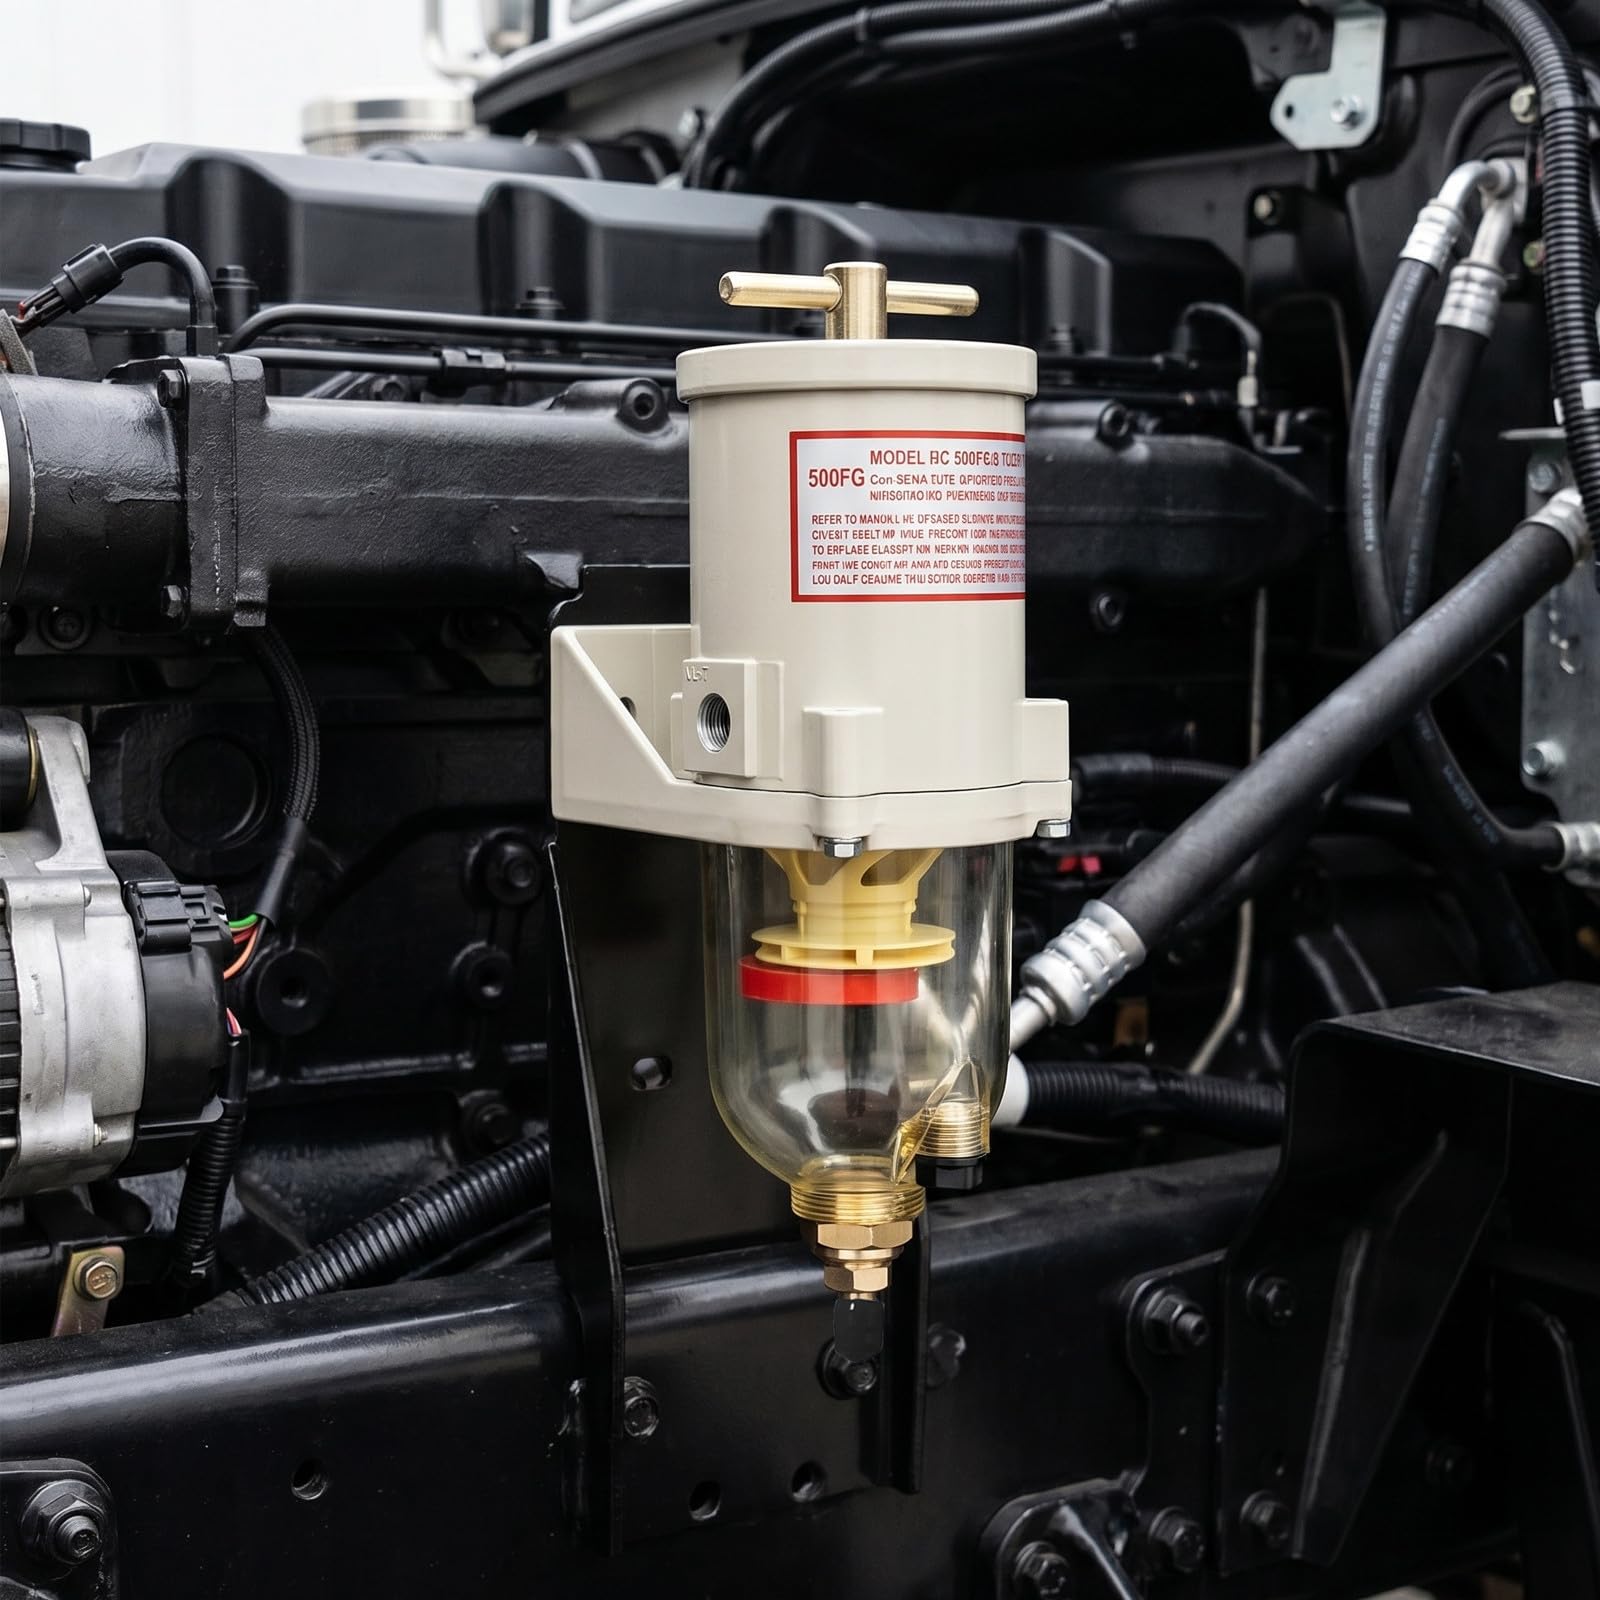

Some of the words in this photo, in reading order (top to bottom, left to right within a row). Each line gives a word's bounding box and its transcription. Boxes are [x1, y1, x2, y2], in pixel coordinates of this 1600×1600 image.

[870, 450, 925, 465] MODEL
[808, 468, 865, 487] 500FG
[812, 514, 842, 525] REFER
[845, 514, 857, 524] TO
[812, 545, 824, 555] TO
